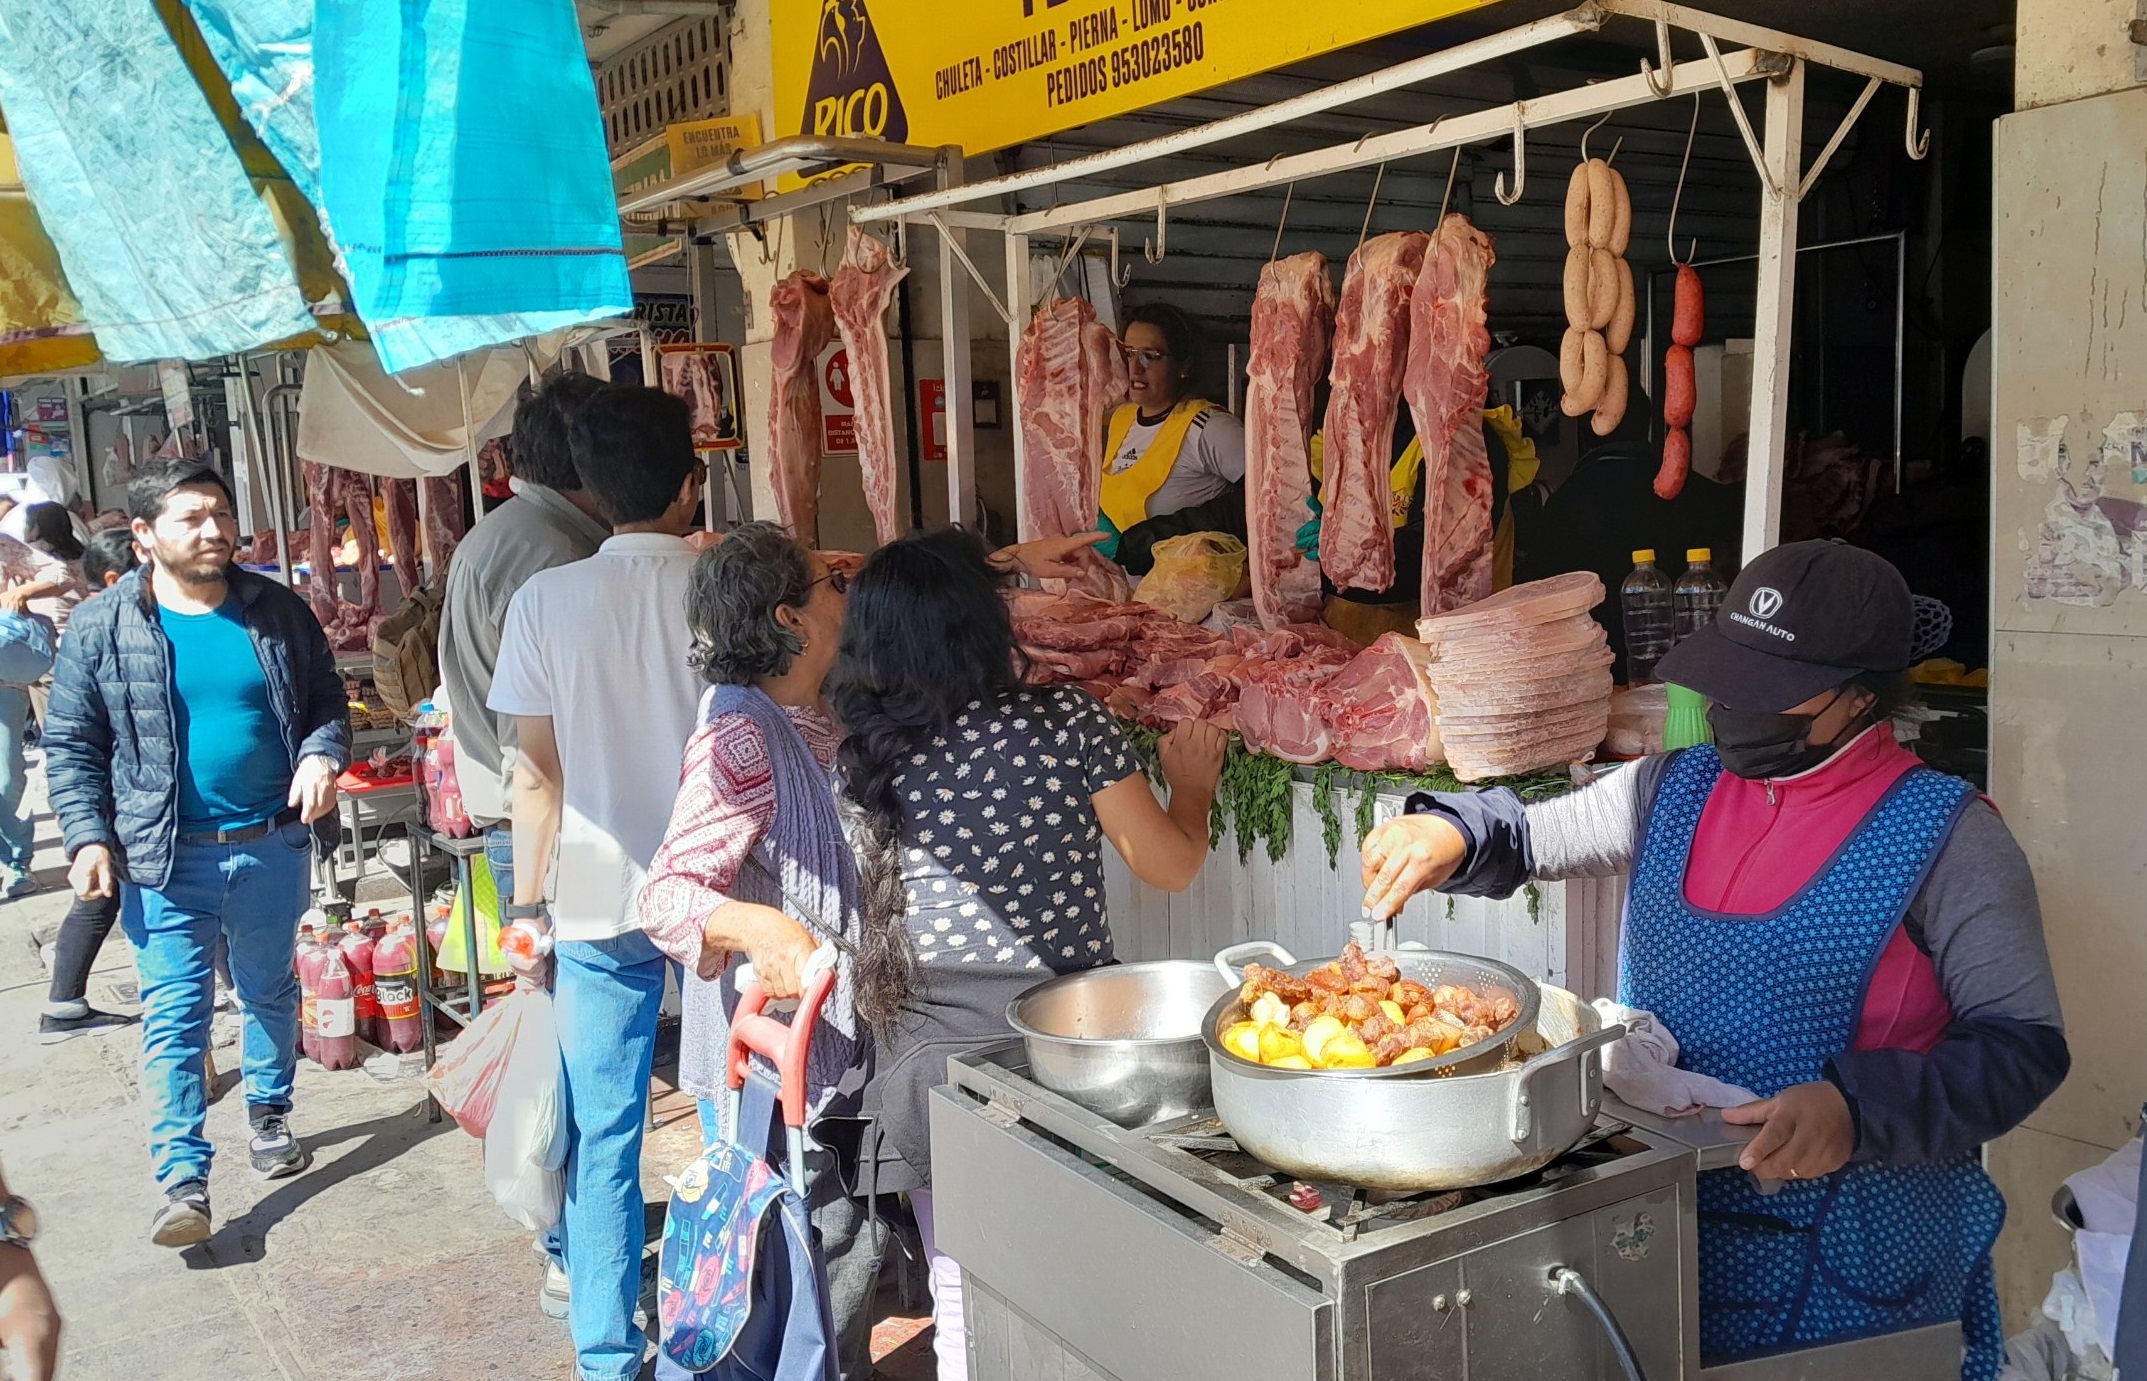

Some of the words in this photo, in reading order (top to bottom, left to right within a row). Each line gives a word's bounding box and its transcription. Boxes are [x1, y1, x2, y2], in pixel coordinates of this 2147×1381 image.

[936, 55, 982, 100] CHULETA
[993, 28, 1057, 80] COSTILLAR
[1069, 6, 1119, 54] PIERNA
[1046, 54, 1108, 108] PEDIDOS
[1112, 21, 1204, 88] 953023580
[814, 82, 888, 136] RICO
[682, 126, 740, 145] ENCUENTRA
[696, 147, 709, 158] LO
[1730, 612, 1767, 631] CHANGAN
[1765, 625, 1795, 642] AUTO
